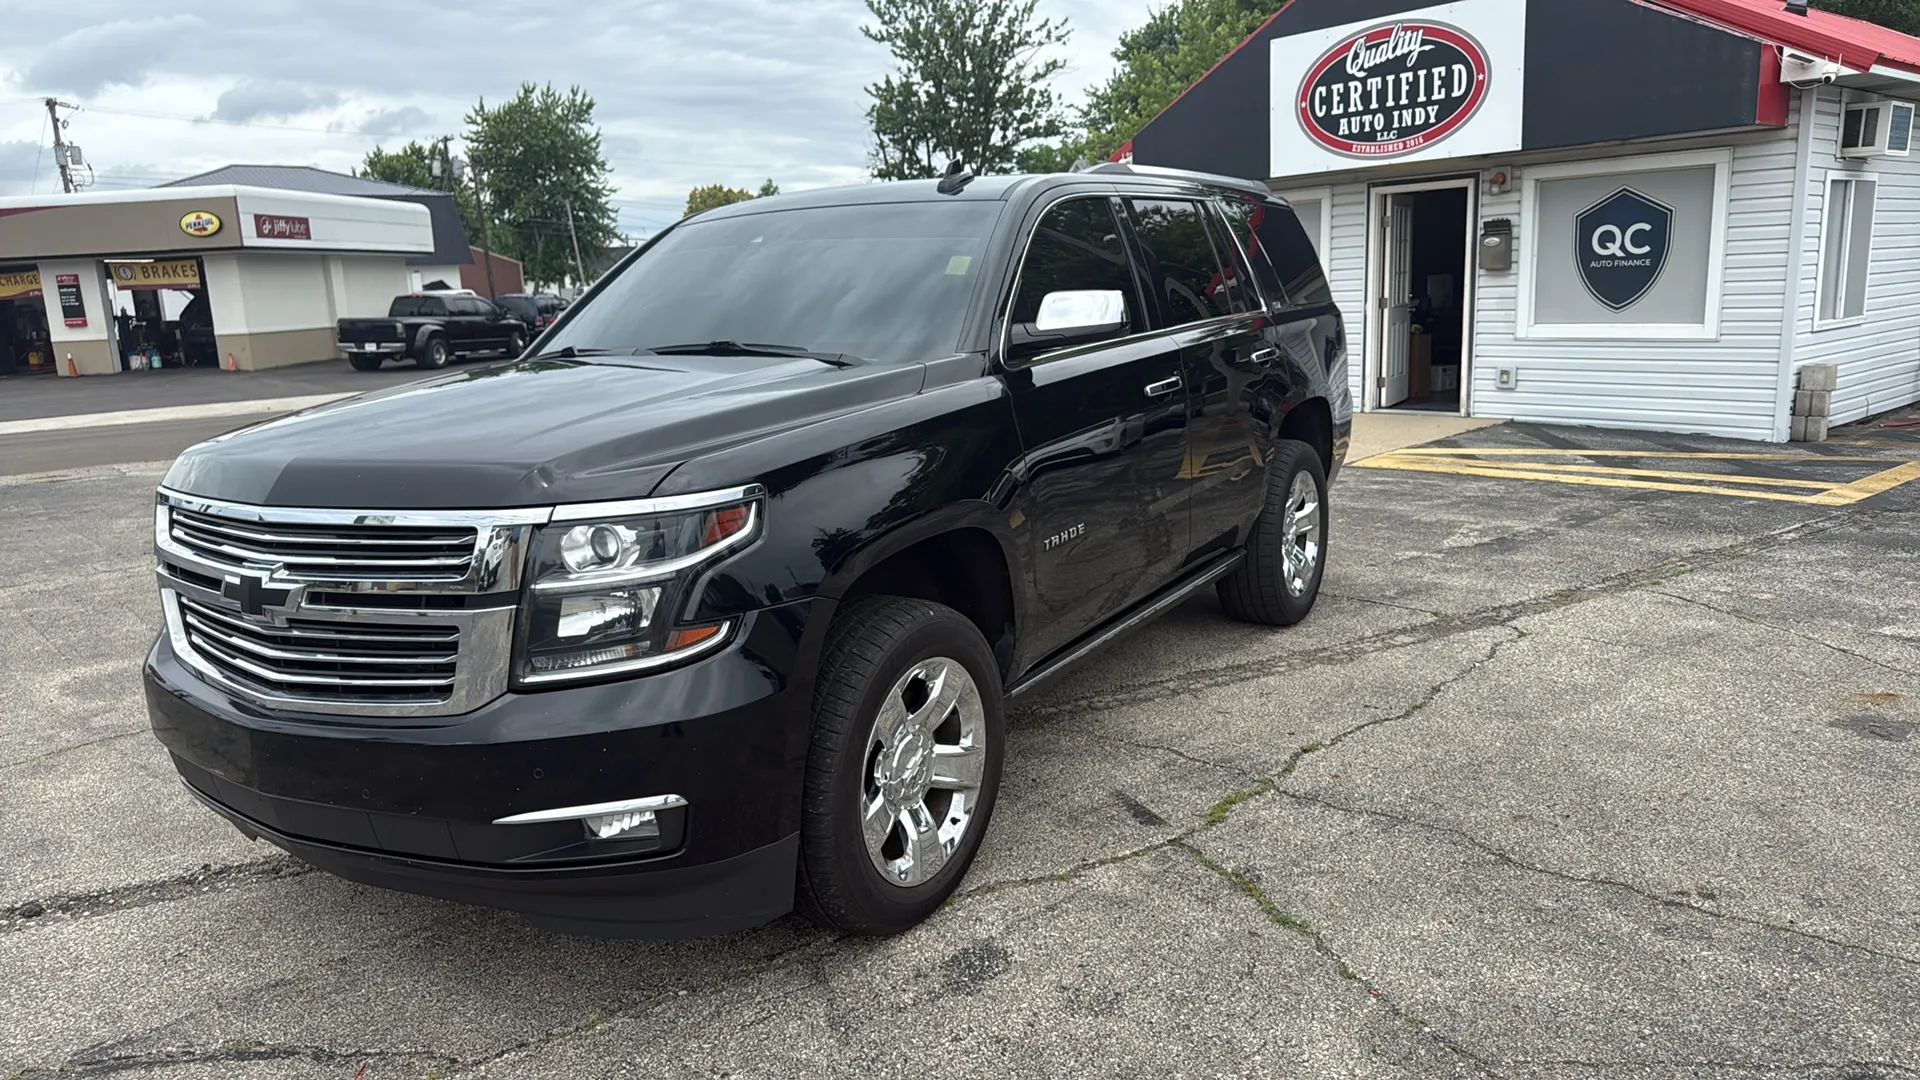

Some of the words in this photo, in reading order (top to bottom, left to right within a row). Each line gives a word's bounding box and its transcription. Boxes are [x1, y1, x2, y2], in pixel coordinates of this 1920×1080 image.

[1346, 23, 1435, 77] Quality
[1314, 64, 1468, 117] CERTIFIED
[1338, 113, 1384, 135] AUTO
[1392, 104, 1440, 128] INDY
[1351, 142, 1404, 153] ESTABLISHED
[1376, 130, 1398, 141] LLC
[1591, 222, 1652, 257] QC
[141, 264, 198, 279] BRAKES
[1590, 260, 1612, 268] AUTO
[1614, 259, 1651, 267] FINANCE
[1043, 522, 1085, 550] TAHOE
